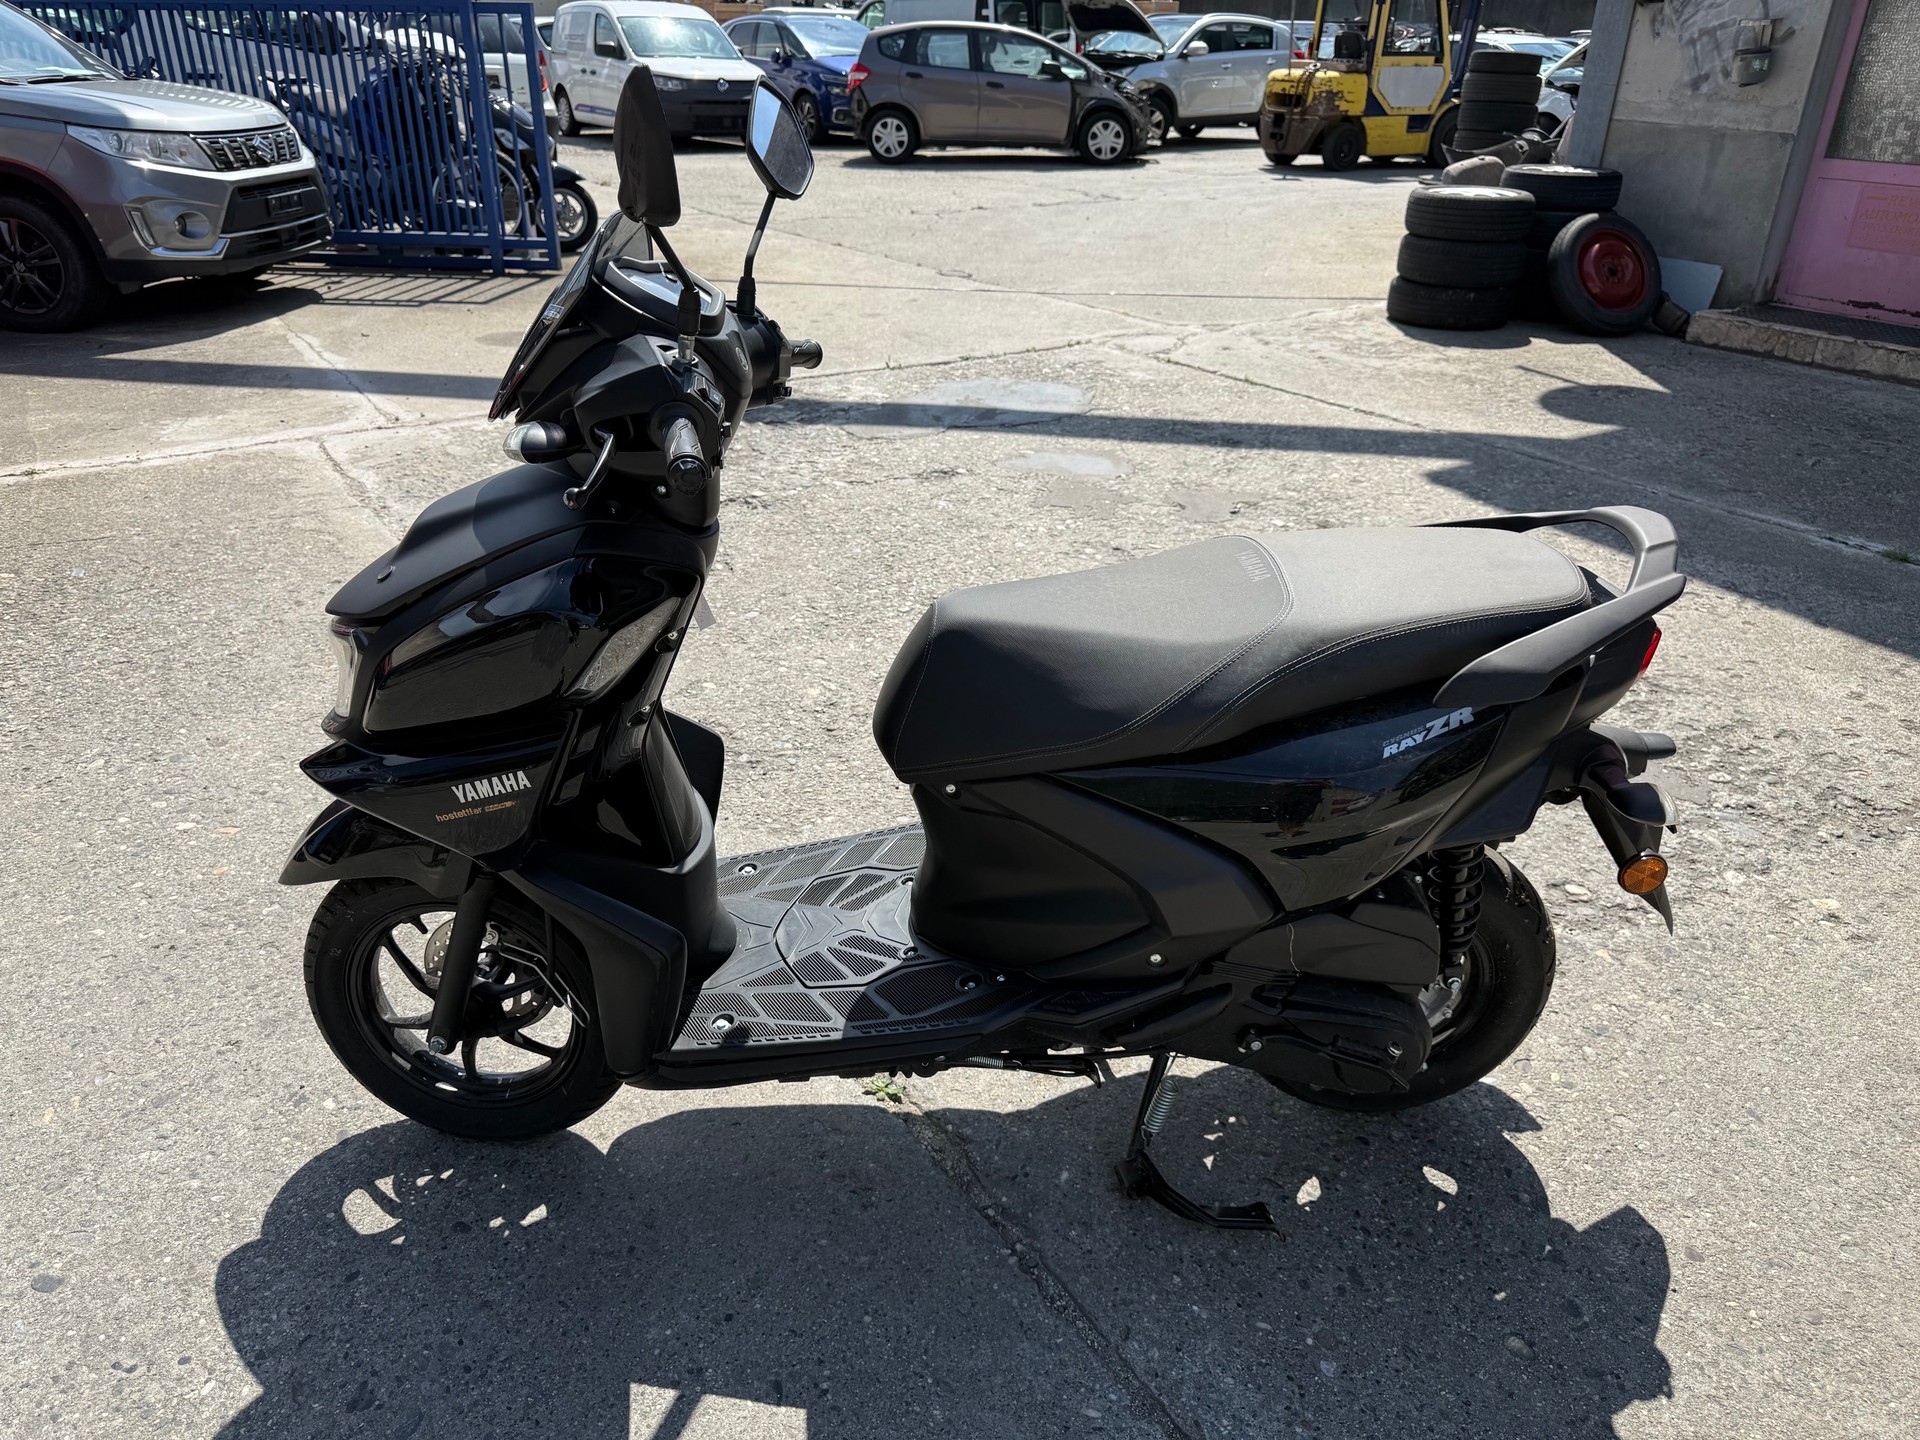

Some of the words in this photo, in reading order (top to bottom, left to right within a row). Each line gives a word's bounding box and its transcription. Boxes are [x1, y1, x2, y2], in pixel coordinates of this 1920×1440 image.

[1859, 208, 1920, 224] AUTOMO
[451, 770, 532, 803] YAMAHA
[435, 806, 483, 822] hostettler
